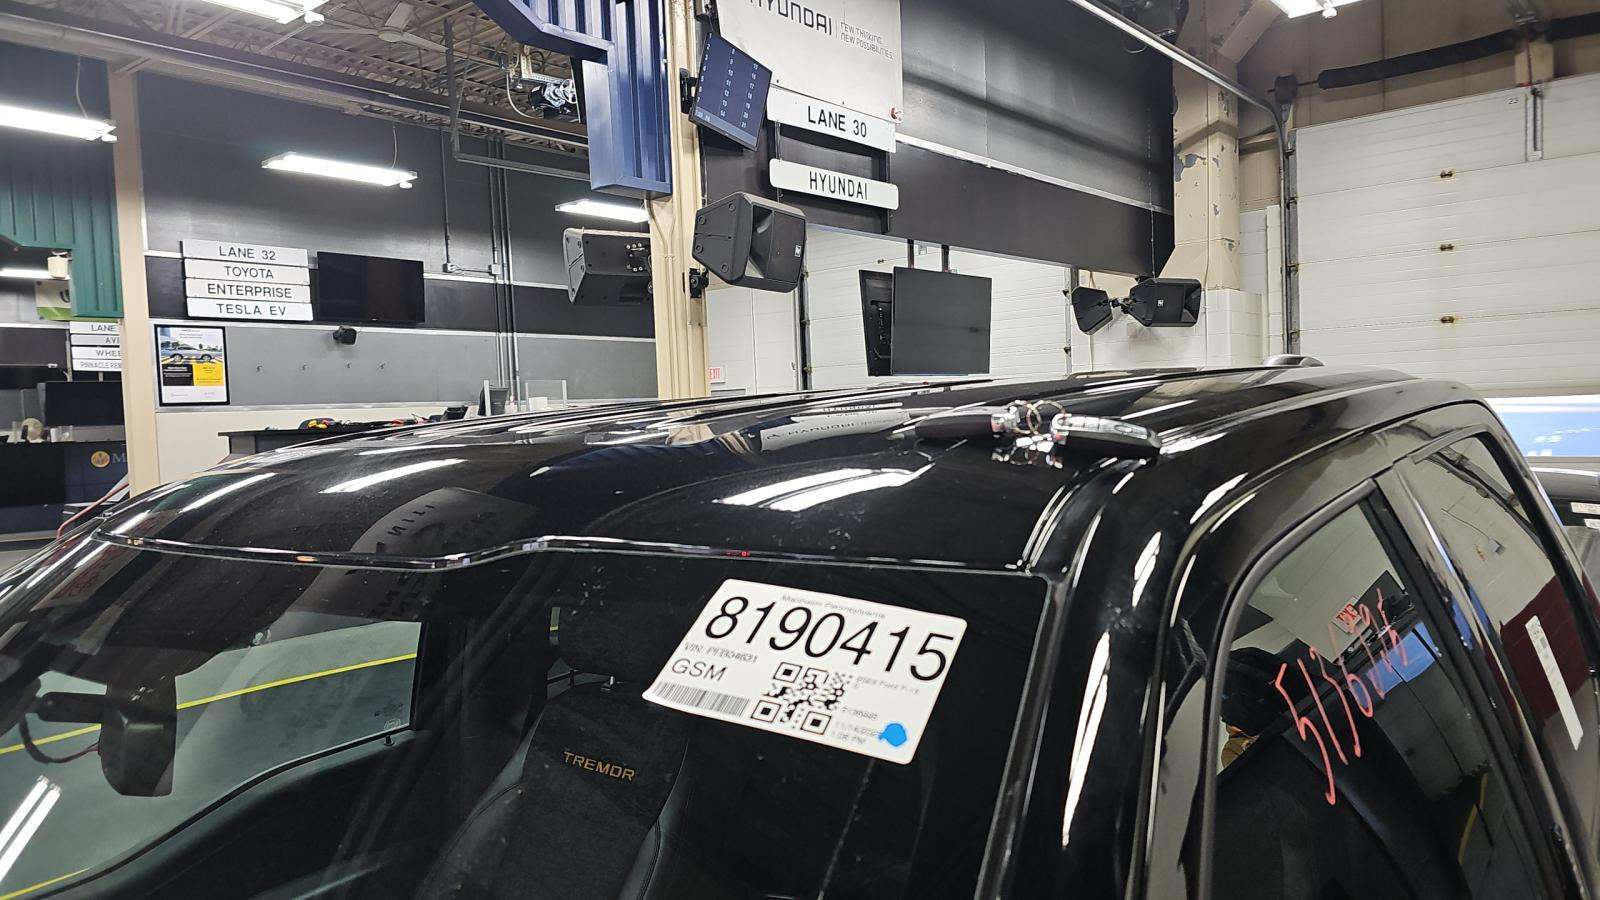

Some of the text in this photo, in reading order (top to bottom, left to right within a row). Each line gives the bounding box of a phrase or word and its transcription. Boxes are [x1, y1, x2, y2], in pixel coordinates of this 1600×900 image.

[750, 0, 832, 35] YUNDAI
[807, 105, 867, 138] LANE 30
[809, 170, 868, 201] HYUNDAI
[219, 246, 276, 260] LANE 32
[224, 266, 274, 279] TOYOTA
[207, 283, 293, 298] ENTERPRISE
[216, 303, 286, 316] TESLA EV
[91, 324, 117, 332] LANE
[708, 367, 721, 380] EXIT
[704, 596, 955, 681] 8190415
[672, 658, 728, 682] GSM
[563, 751, 636, 781] TREMOR
